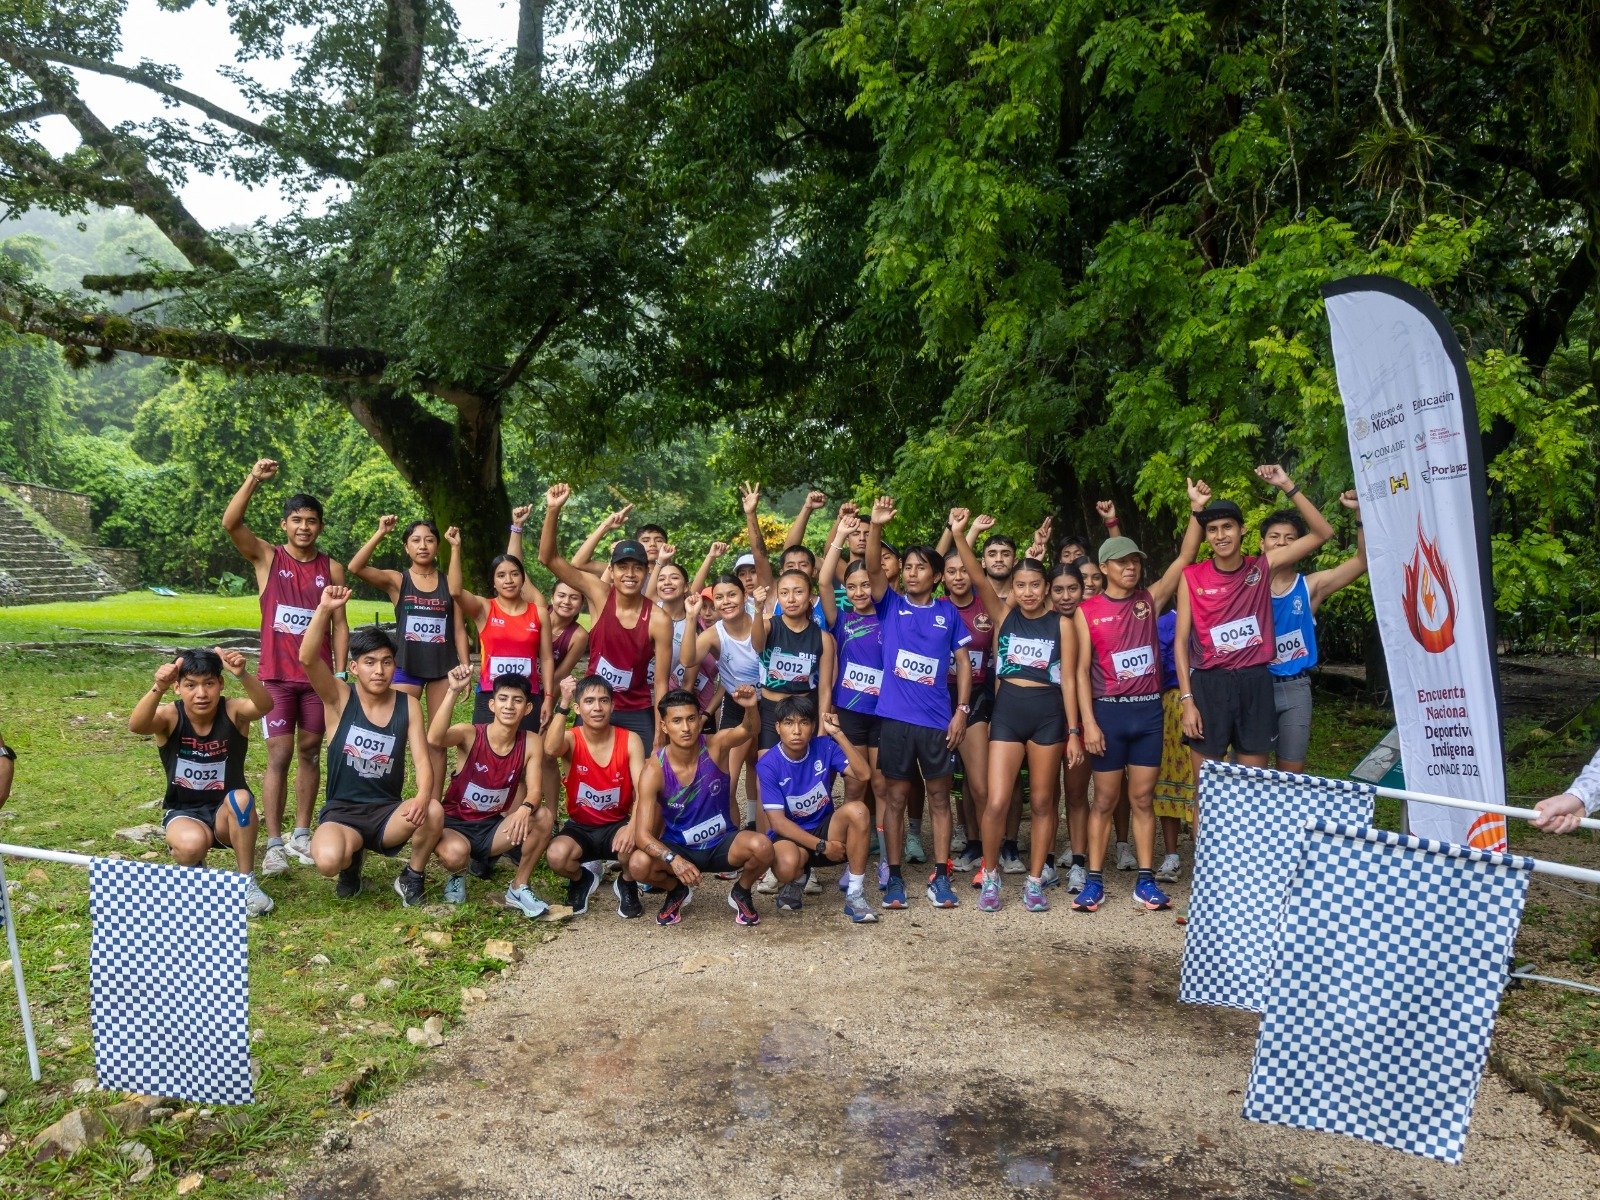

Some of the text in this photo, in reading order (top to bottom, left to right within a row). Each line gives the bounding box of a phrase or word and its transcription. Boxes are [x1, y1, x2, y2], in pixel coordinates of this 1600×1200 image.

[1372, 413, 1404, 433] México
[1374, 439, 1405, 458] CONADE
[1431, 463, 1468, 475] Por la paz
[283, 613, 312, 626] 0027
[413, 622, 441, 634] 0028
[1220, 624, 1255, 643] 0043
[1014, 644, 1043, 658] 0016
[497, 663, 525, 674] 0019
[776, 660, 803, 673] 0012
[902, 658, 933, 674] 0030
[1121, 654, 1148, 669] 0017
[601, 667, 623, 684] 0011
[849, 670, 876, 685] 0018
[1118, 692, 1160, 703] ARMOUR
[1417, 686, 1466, 703] Encuentr
[1426, 704, 1469, 720] Naciona
[1424, 722, 1473, 741] Deportiv
[354, 735, 385, 753] 0031
[184, 768, 218, 780] 0032
[1427, 763, 1480, 777] CONADE 202
[471, 792, 501, 804] 0014
[585, 790, 612, 804] 0013
[795, 790, 823, 810] 0024
[693, 823, 721, 843] 0007
